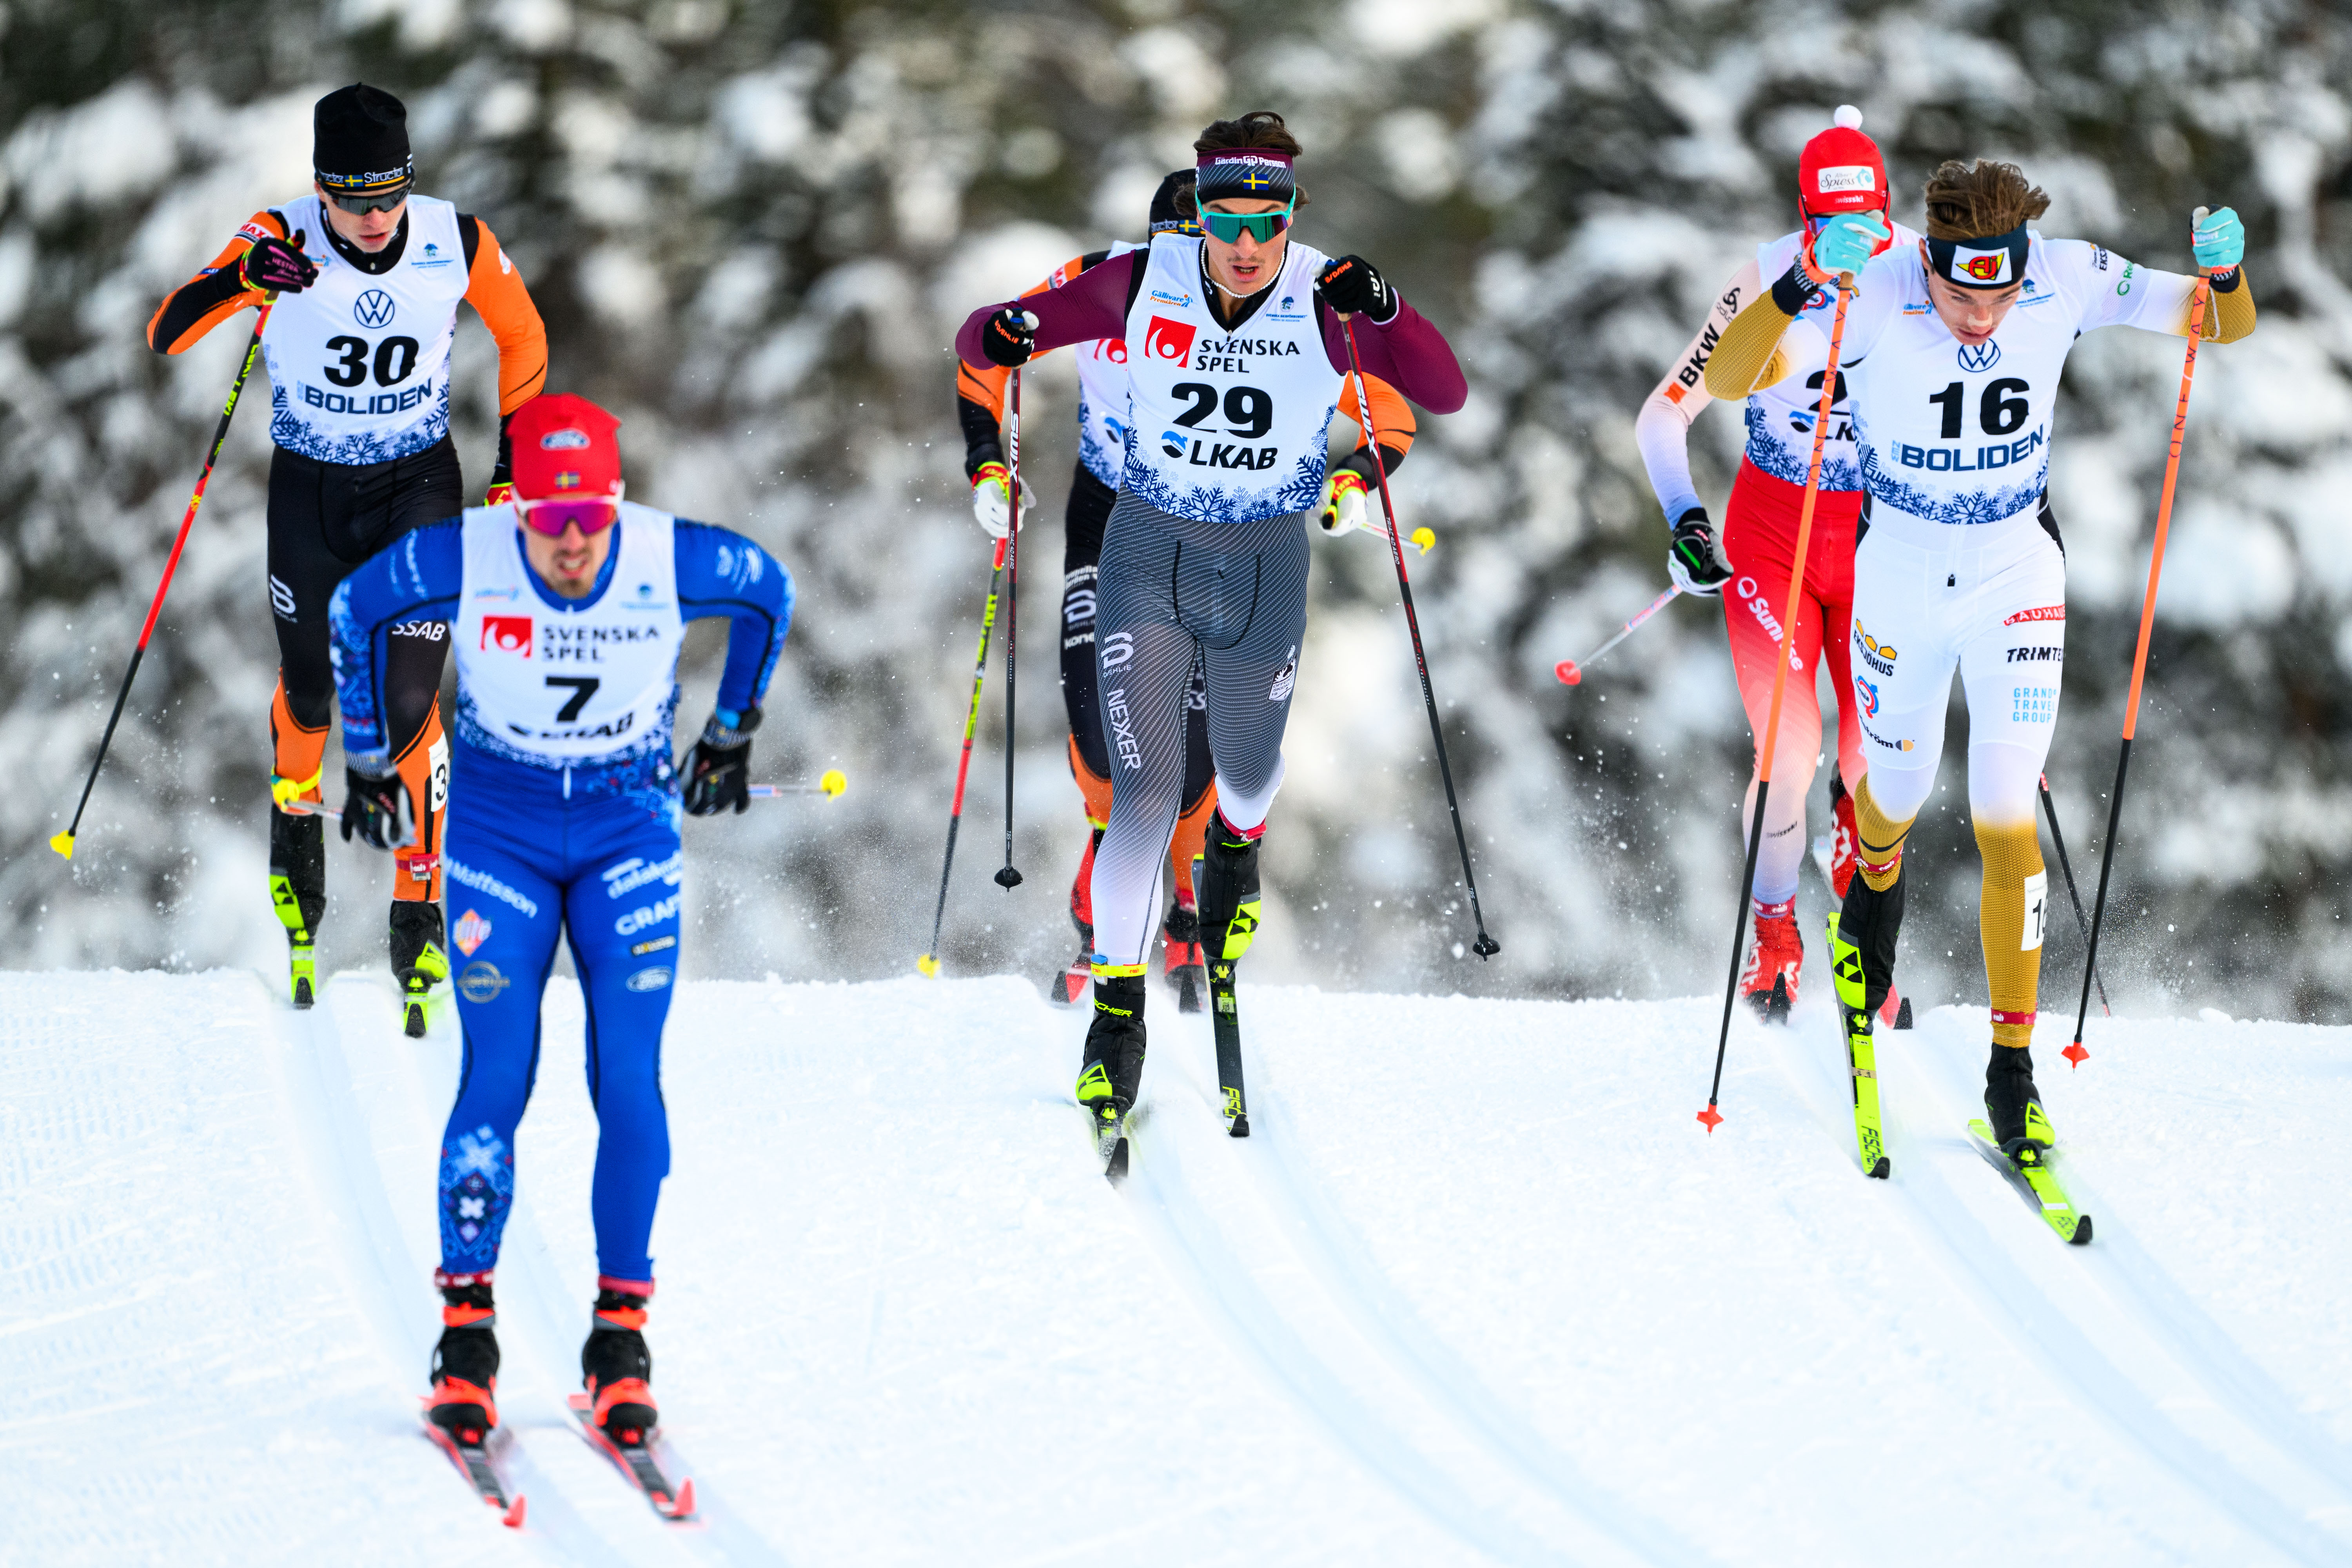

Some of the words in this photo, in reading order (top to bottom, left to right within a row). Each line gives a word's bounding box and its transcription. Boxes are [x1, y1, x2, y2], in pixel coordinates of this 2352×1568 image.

[1215, 157, 1243, 165] Gärdin
[1258, 157, 1286, 168] Persson
[319, 170, 344, 183] ctor
[364, 166, 403, 183] Structor
[1820, 174, 1855, 190] Spiess
[1834, 195, 1864, 204] swissski
[240, 223, 270, 238] MAX
[1150, 296, 1181, 306] Premiären
[1152, 290, 1184, 302] Gällivare
[1199, 339, 1300, 356] SVENSKA
[1679, 323, 1720, 388] BKW
[324, 335, 419, 388] 30
[1195, 356, 1250, 373] SPEL
[305, 377, 432, 414] BOLIDEN
[1806, 370, 1851, 416] 2
[1171, 382, 1273, 439] 29
[1352, 371, 1379, 459] SWIX
[1929, 377, 2030, 439] 16
[1009, 410, 1019, 483] SWIX
[1189, 439, 1278, 470] LKAB
[1901, 423, 2043, 472] BOLIDEN
[392, 620, 446, 641] SSAB
[542, 624, 660, 644] SVENSKA
[1748, 597, 1804, 671] Sunrse
[542, 646, 604, 661] SPEL
[1854, 629, 1895, 677] EKSJÖHUS
[2006, 647, 2063, 663] TRIMTE
[1103, 664, 1132, 678] DÆHLIE
[1273, 673, 1294, 688] OFFERD
[1273, 678, 1294, 692] SKIDKL
[2014, 688, 2053, 699] GRAND
[545, 675, 600, 723] 7
[2014, 699, 2055, 712] TRAVEL
[2013, 711, 2052, 723] GROUP
[1107, 688, 1141, 770] NEXER
[436, 764, 447, 801] 3
[614, 892, 681, 936] CRAF
[1094, 997, 1132, 1017] SCHER
[1222, 1085, 1242, 1119] FISC
